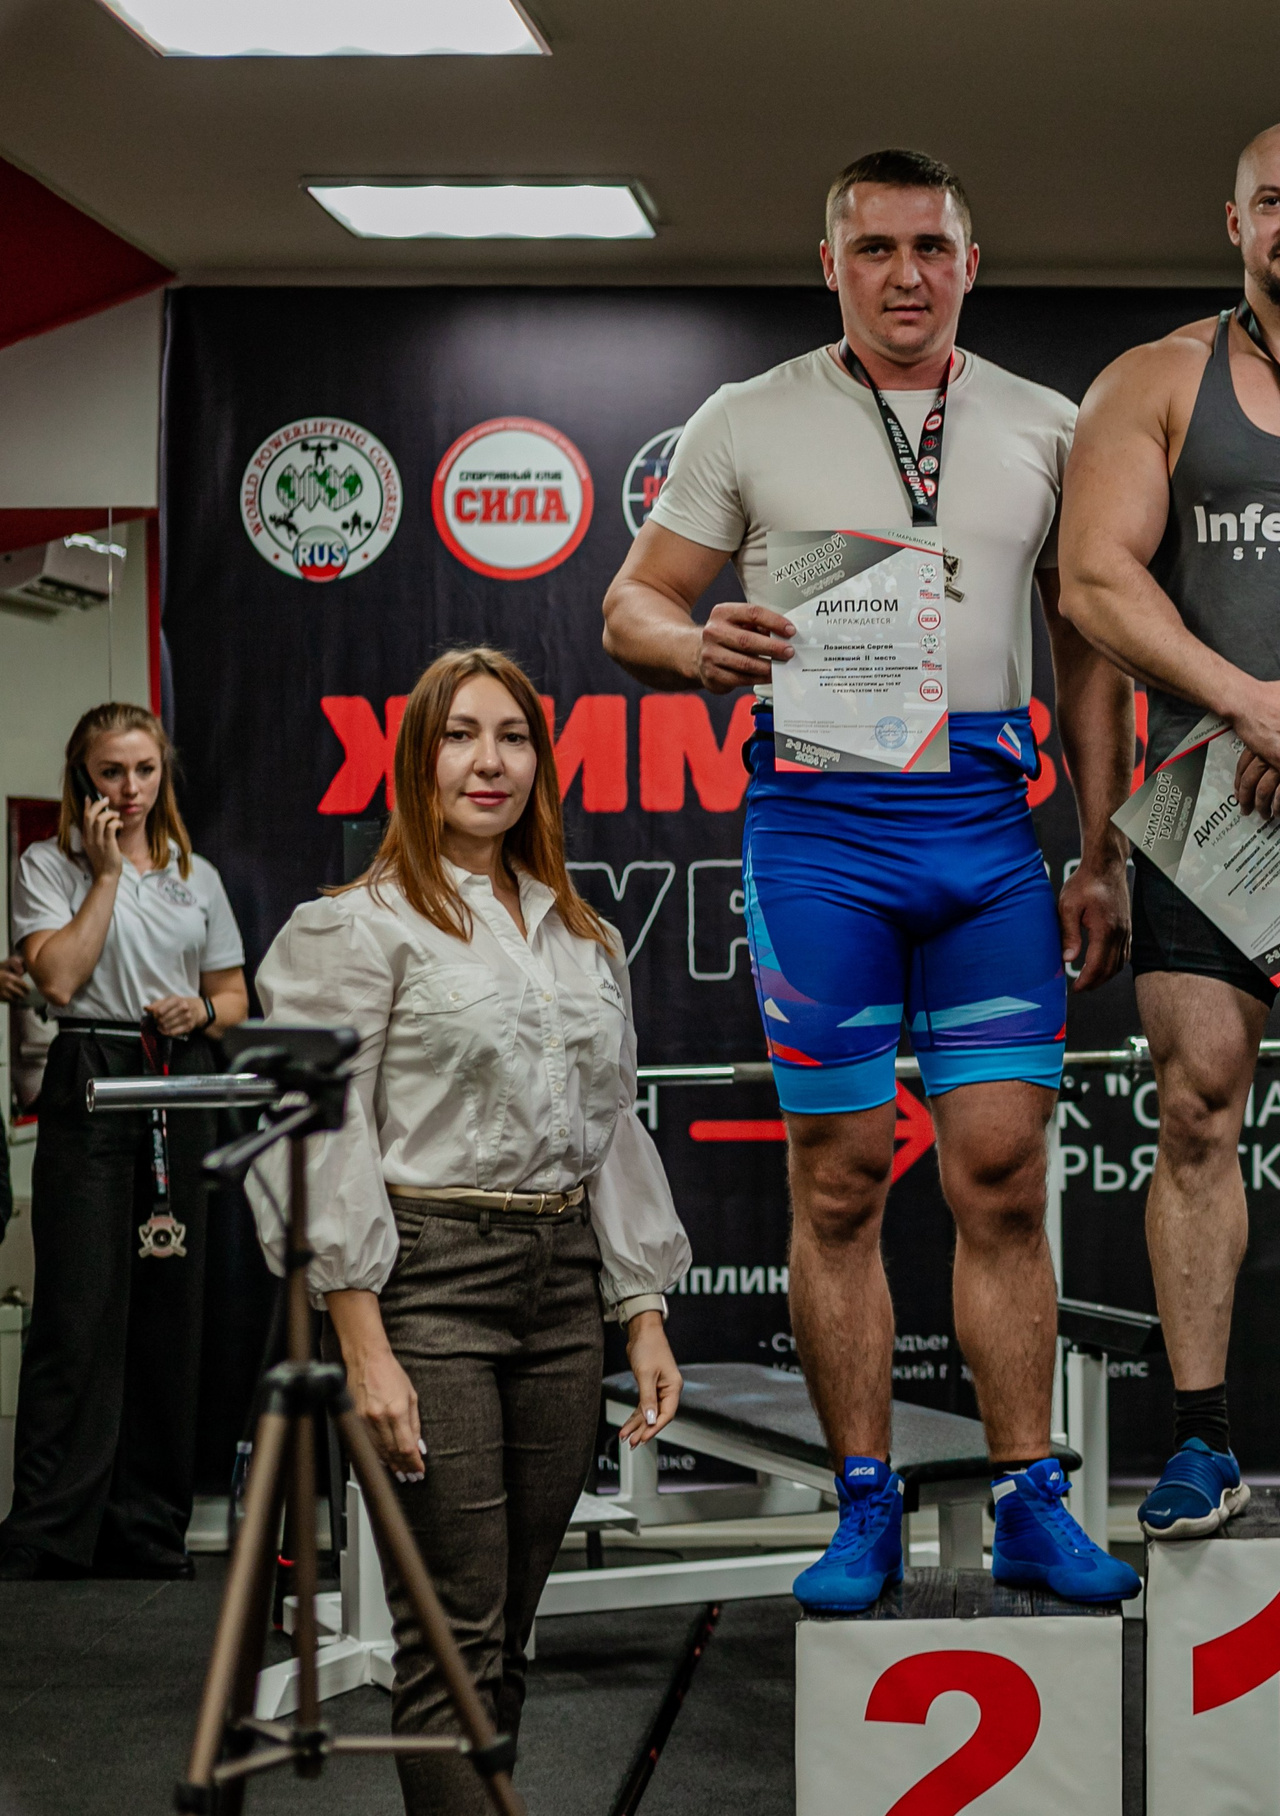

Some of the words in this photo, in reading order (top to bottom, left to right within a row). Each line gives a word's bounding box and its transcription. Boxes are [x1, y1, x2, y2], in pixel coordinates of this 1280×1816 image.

[245, 473, 263, 537] WORLD
[254, 421, 368, 469] POWERLIFTING
[368, 447, 397, 534] CONGRESS
[454, 486, 570, 525] СИЛА
[298, 541, 345, 568] RUS
[770, 532, 847, 584] ЖИМОВОЙ
[790, 553, 843, 588] ТУРНИР
[816, 599, 899, 616] ДИПЛОМ
[826, 617, 891, 626] НАГРАЖДАЕТСЯ
[823, 643, 866, 651] Лозинский
[867, 643, 894, 651] Сергей
[1141, 771, 1173, 851] ЖИМОВОЙ
[1157, 784, 1183, 841] ТУРНИР
[1192, 794, 1240, 848] ДИПЛО
[1210, 814, 1243, 848] НАГРАЖДА
[864, 1650, 1042, 1816] 2
